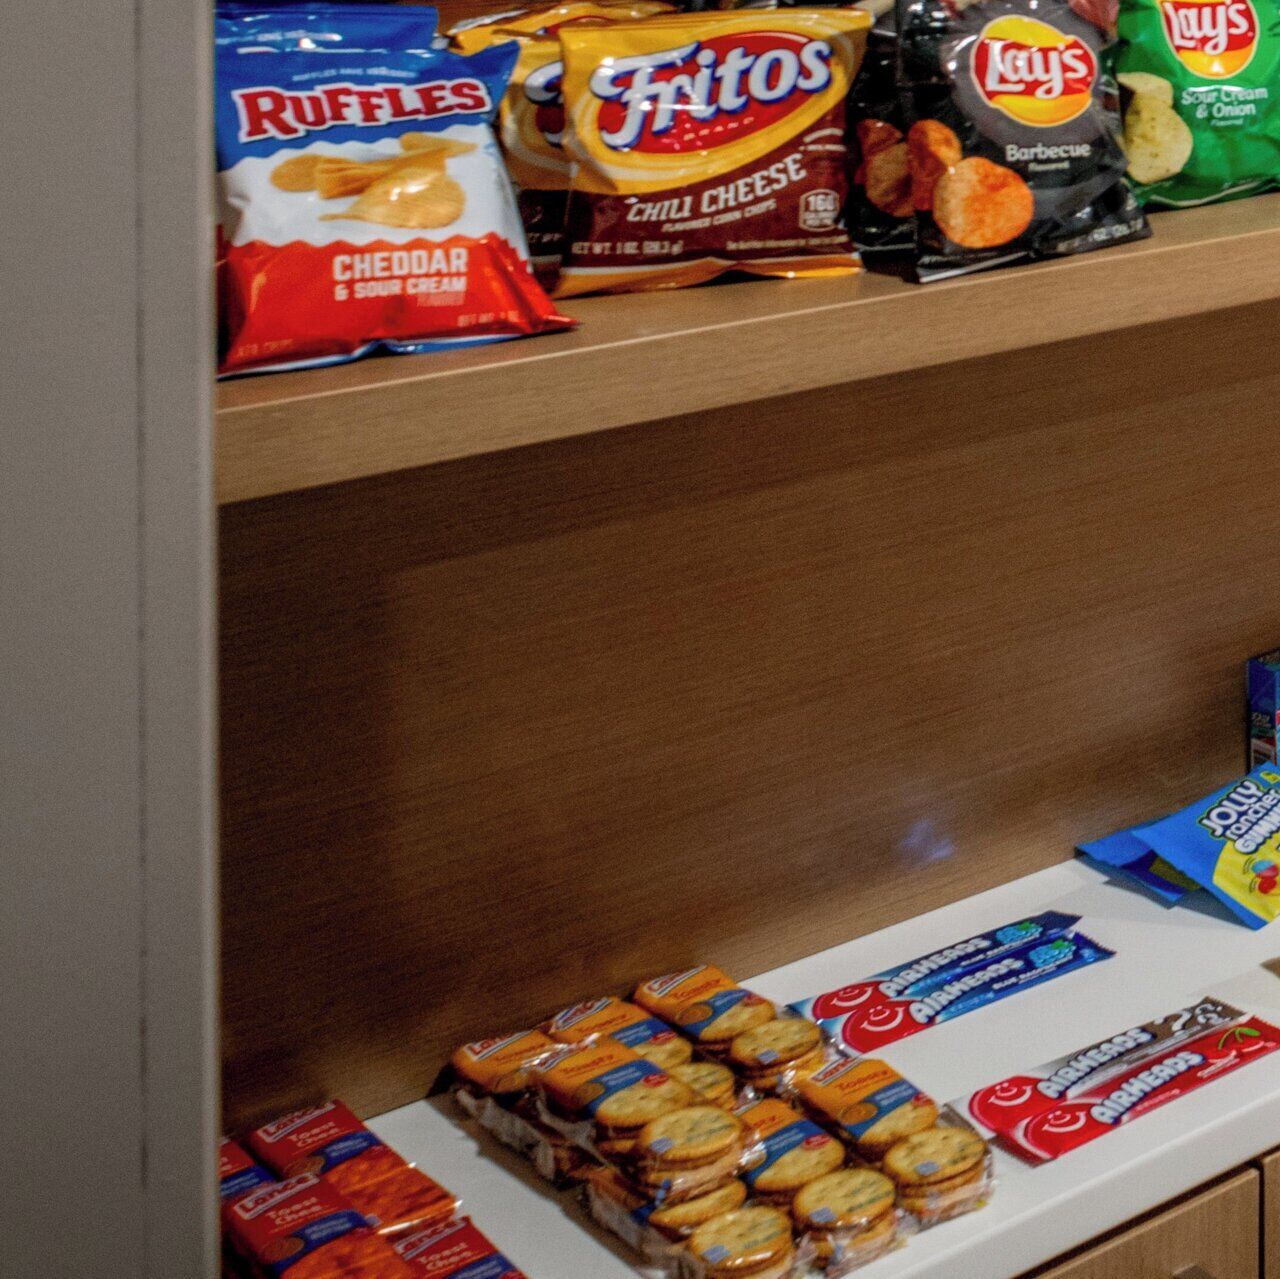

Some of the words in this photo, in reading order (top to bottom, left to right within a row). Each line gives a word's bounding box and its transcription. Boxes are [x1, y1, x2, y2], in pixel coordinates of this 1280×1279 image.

[590, 41, 832, 150] Fritos
[985, 39, 1092, 99] Lay's
[1182, 88, 1216, 104] Sour
[1219, 87, 1268, 104] Cream
[240, 82, 487, 139] RUFFLES
[1196, 103, 1209, 118] &
[1212, 101, 1256, 117] Onion
[1005, 143, 1091, 162] Barbecue
[627, 195, 692, 223] CHILI
[701, 154, 807, 213] CHEESE
[334, 248, 468, 281] CHEDDAR
[335, 284, 348, 301] &
[354, 279, 401, 298] SOUR
[407, 277, 466, 294] CREAM
[1199, 780, 1264, 837] JOLLY
[879, 937, 992, 997] AIRHEADS
[909, 957, 1024, 1024] AIRHEADS
[1036, 1026, 1156, 1098] AIRHEADS
[1090, 1051, 1206, 1124] AIRHEADS
